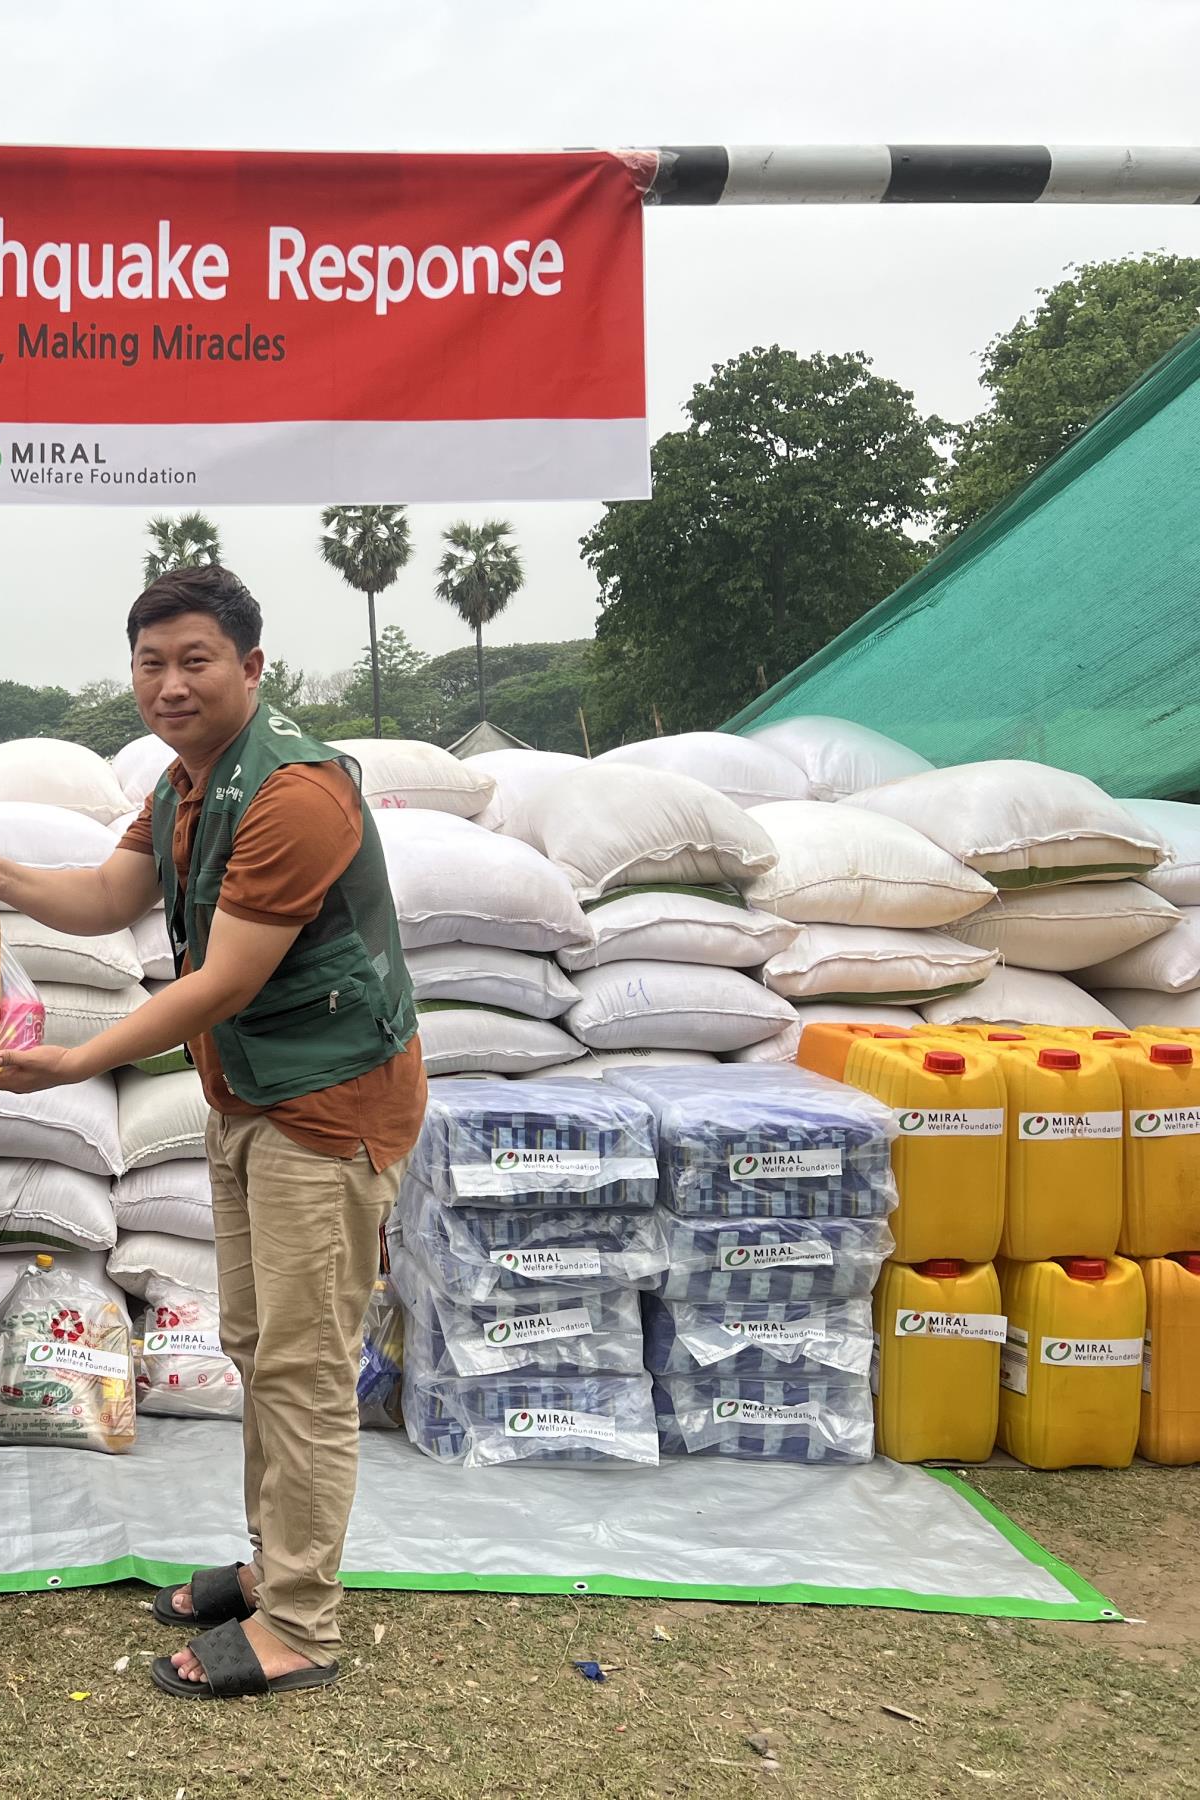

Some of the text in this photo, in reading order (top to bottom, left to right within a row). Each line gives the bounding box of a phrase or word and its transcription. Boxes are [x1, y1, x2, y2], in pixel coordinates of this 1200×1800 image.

[268, 226, 564, 315] Response
[18, 321, 140, 366] Making
[153, 323, 285, 363] Miracles
[11, 442, 107, 464] MIRAL
[10, 467, 197, 484] Welfare Foundation
[928, 1113, 968, 1122] MIRAL
[1052, 1116, 1092, 1126] MIRAL
[927, 1122, 959, 1131] Welfare
[1164, 1121, 1195, 1130] Welfare
[523, 1153, 562, 1163] MIRAL
[762, 1155, 803, 1165] MIRAL
[762, 1162, 840, 1173] Welfare Foundation
[753, 1246, 794, 1257] MIRAL
[522, 1254, 562, 1263] MIRAL
[523, 1262, 599, 1271] Welfare Foundation
[513, 1317, 553, 1331] MIRAL
[929, 1316, 969, 1327] MIRAL
[515, 1322, 590, 1339] Welfare Foundation
[748, 1323, 786, 1332] MIRAL
[928, 1326, 1005, 1337] Welfare Foundation
[171, 1334, 205, 1343] MIRAL
[198, 1344, 222, 1352] Found
[1075, 1343, 1113, 1353] MIRAL
[56, 1346, 93, 1361] MIRAL
[1074, 1353, 1104, 1361] Welfare
[56, 1356, 84, 1367] Welfare
[85, 1362, 127, 1375] Foundation
[537, 1413, 576, 1425] MIRAL
[774, 1411, 817, 1421] Foundation
